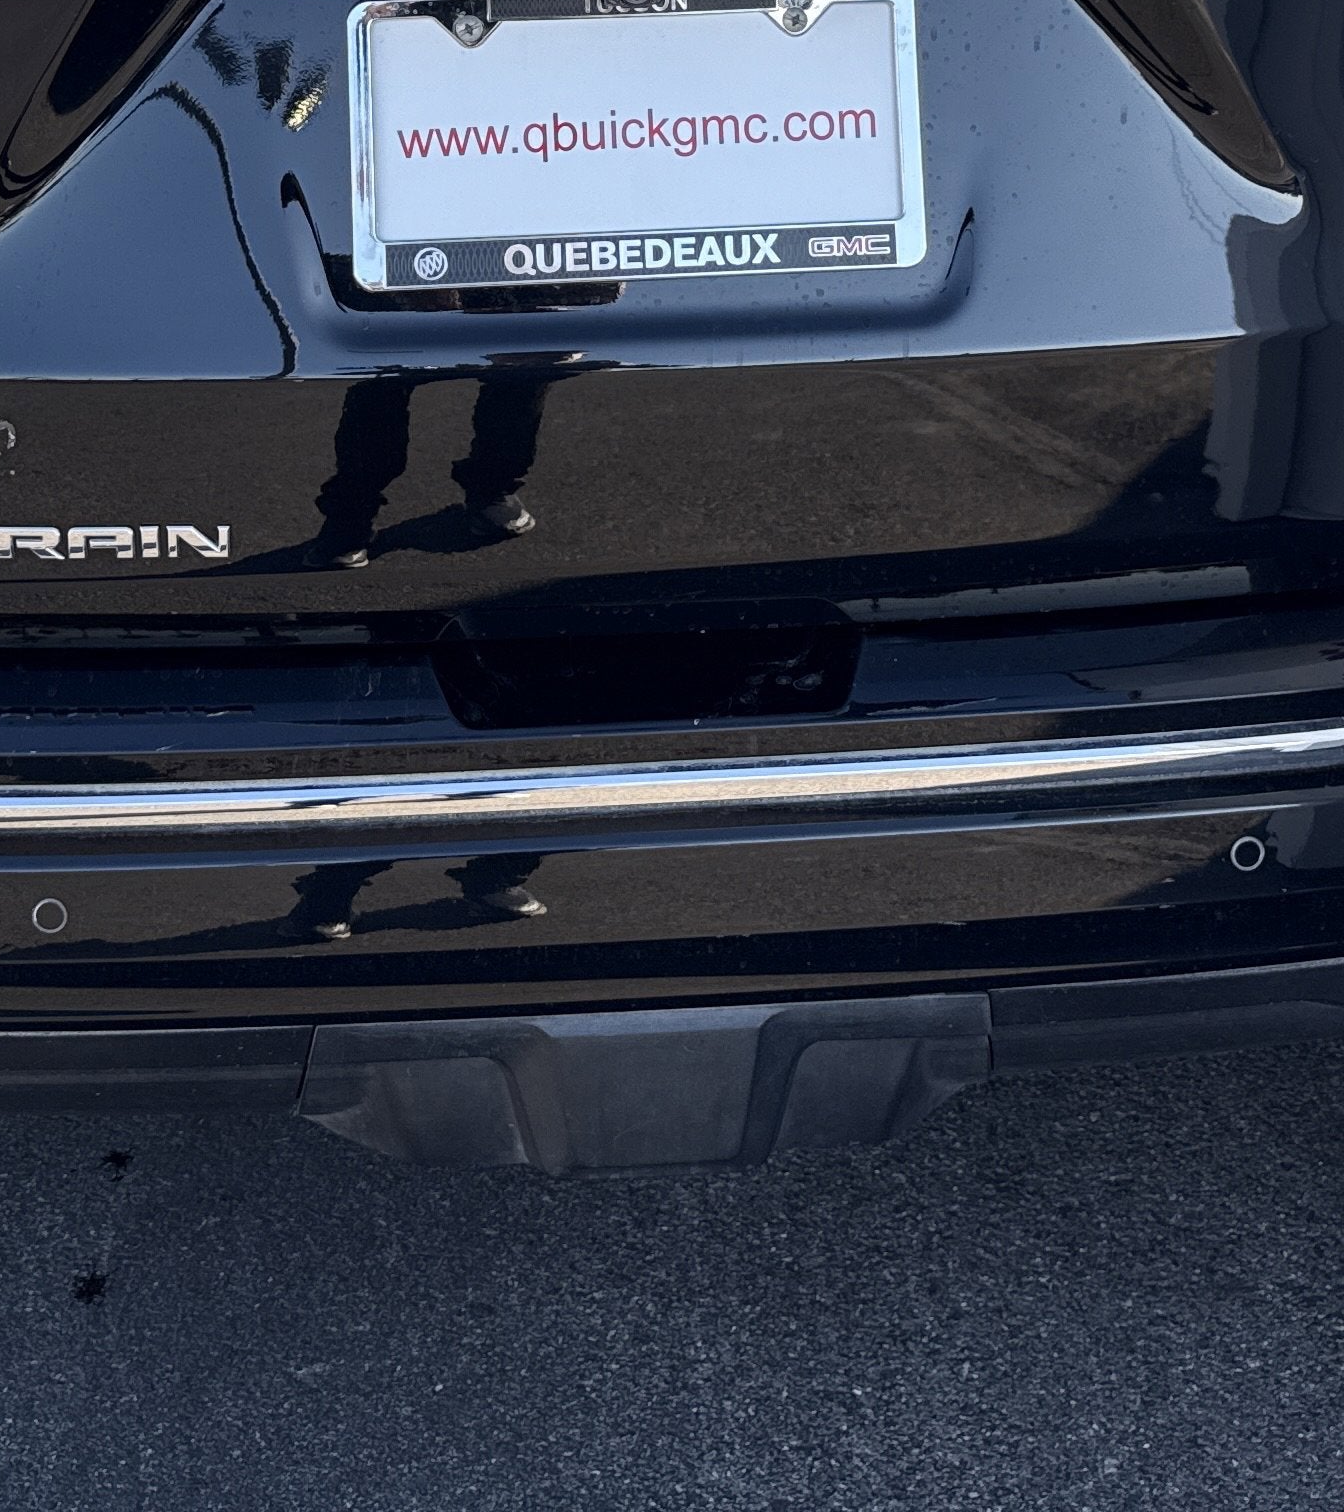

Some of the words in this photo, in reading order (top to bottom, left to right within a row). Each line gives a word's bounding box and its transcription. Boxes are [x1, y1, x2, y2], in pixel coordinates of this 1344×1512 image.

[396, 107, 877, 163] www.qbuickgmc.com
[502, 232, 782, 277] QUEBEDEAUX
[808, 234, 892, 256] GMC
